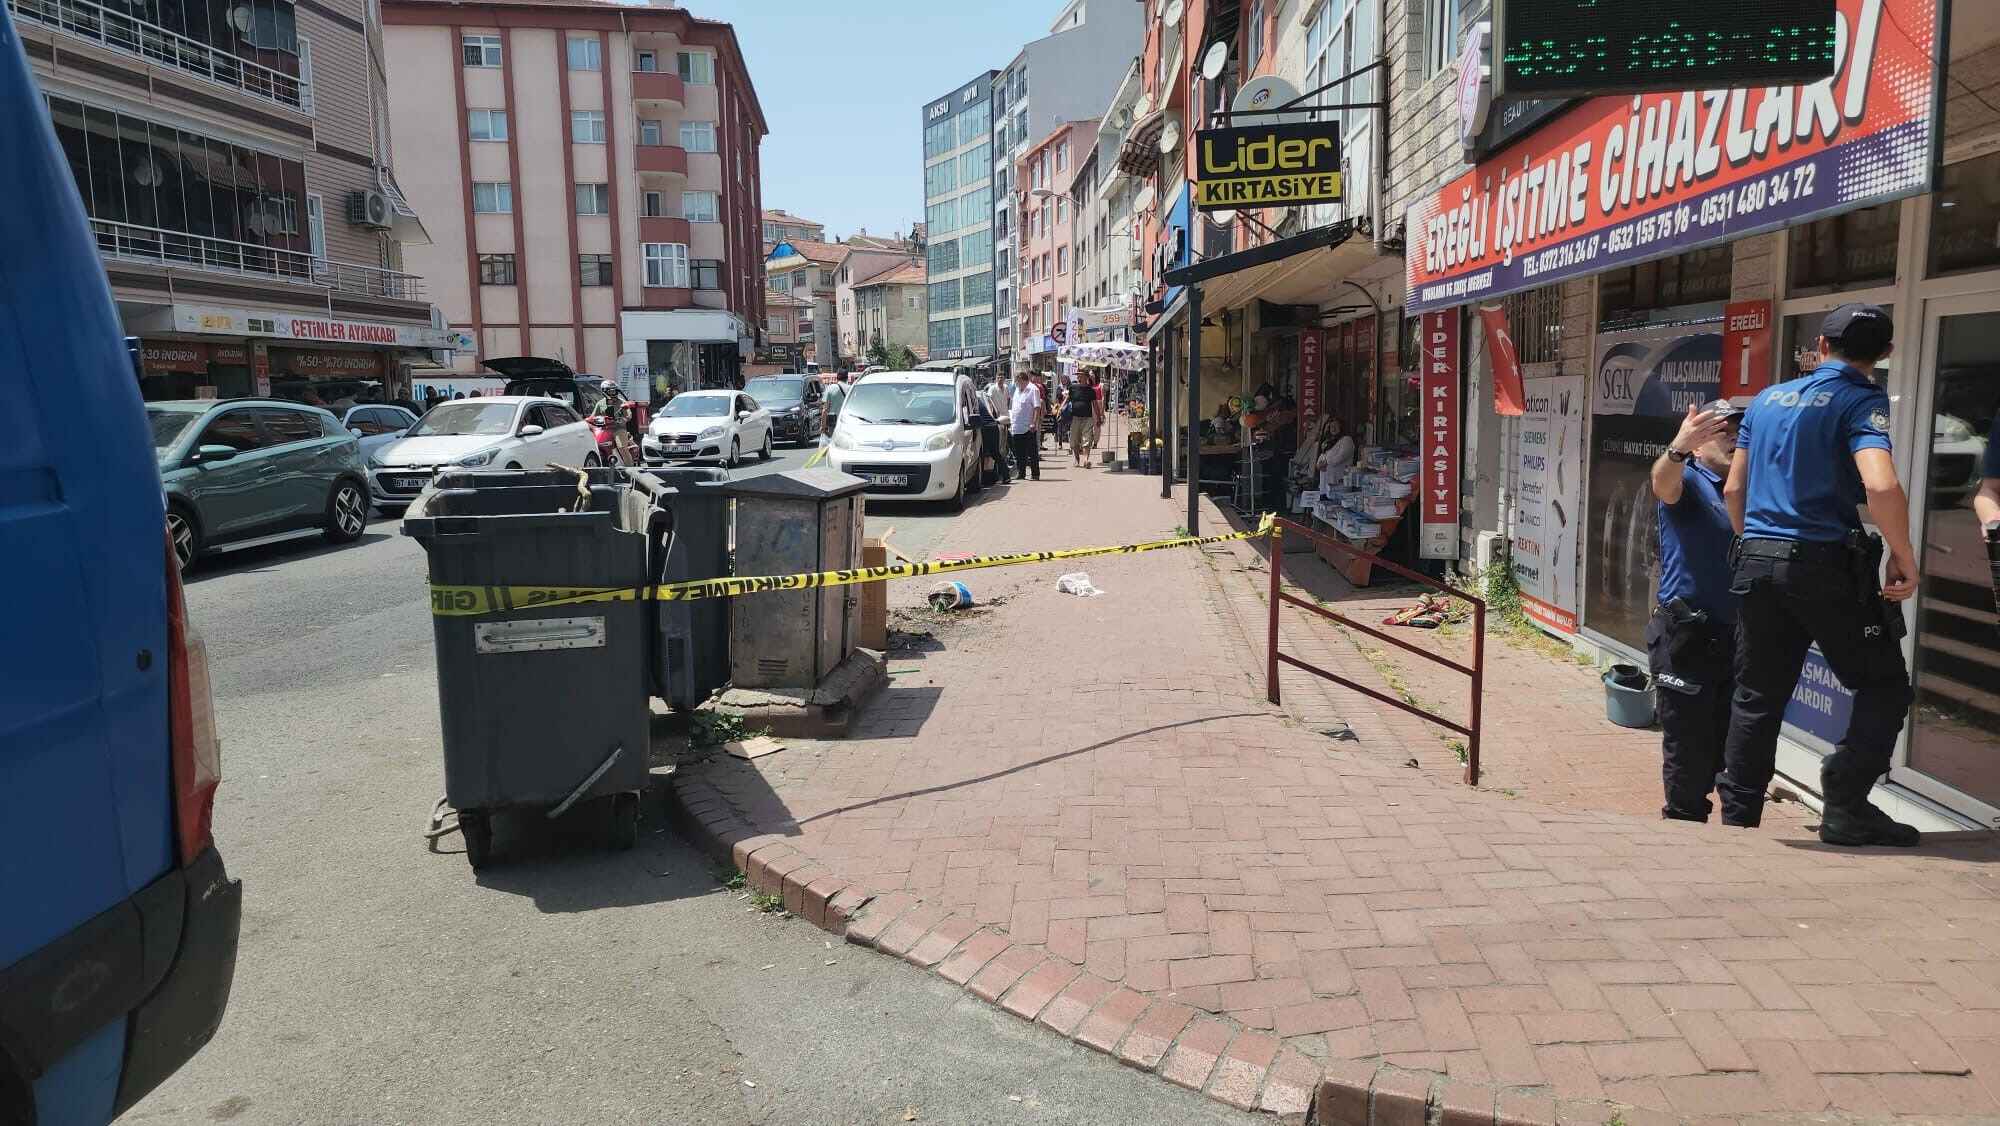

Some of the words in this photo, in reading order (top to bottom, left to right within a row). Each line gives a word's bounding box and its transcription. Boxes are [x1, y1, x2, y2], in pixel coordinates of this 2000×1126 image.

[929, 100, 950, 120] AKSU
[1204, 134, 1332, 173] Lider
[1425, 176, 1491, 276] EREĞLİ
[1494, 140, 1593, 266] İŞİTME
[1539, 251, 1557, 272] 0372
[1557, 245, 1573, 267] 316
[1574, 239, 1587, 264] 24
[1587, 235, 1600, 259] 67
[1608, 227, 1634, 254] 0532
[1635, 215, 1655, 247] 155
[1656, 213, 1672, 240] 75
[1673, 206, 1691, 235] 98
[1700, 189, 1735, 227] 0531
[1736, 179, 1767, 215] 480
[1768, 171, 1790, 207] 34
[1793, 162, 1816, 200] 72
[1103, 314, 1121, 324] 259
[1730, 309, 1765, 332] EREĞLİ
[348, 324, 397, 343] AYAKKABI
[1432, 310, 1448, 374] İDER
[1303, 336, 1317, 373] AKIL
[1603, 368, 1634, 400] SGK
[1660, 360, 1722, 388] ANLAŞMAMIZ
[1303, 379, 1317, 416] ZEKA
[1525, 392, 1549, 413] oticon
[1523, 430, 1546, 445] SIEMENS
[1623, 439, 1644, 456] HAYAT
[1523, 454, 1545, 471] PHILIPS
[1517, 536, 1540, 557] REXTON
